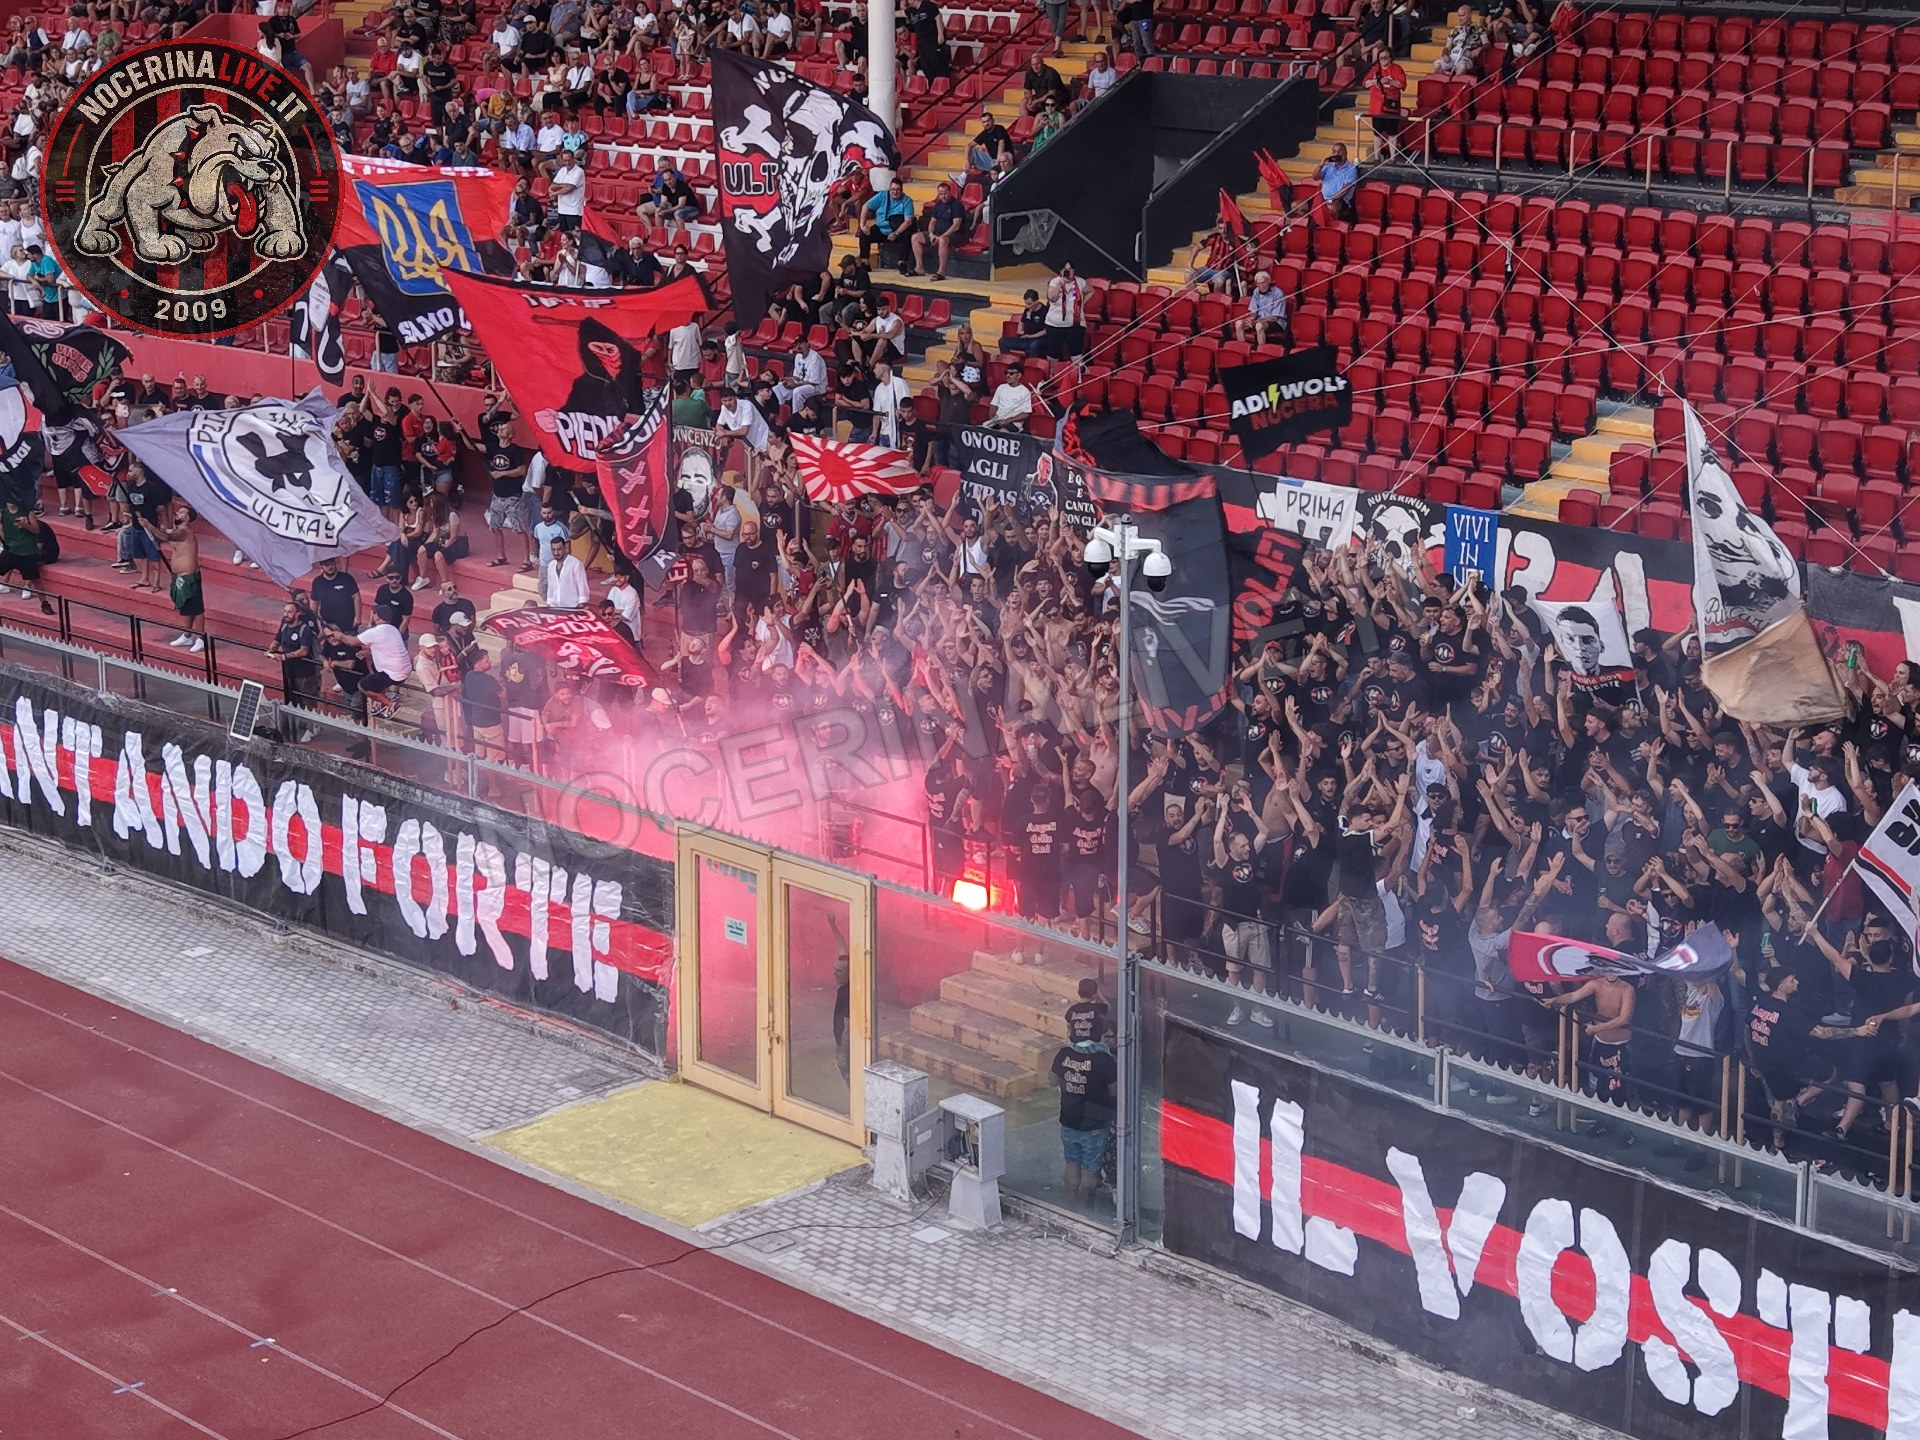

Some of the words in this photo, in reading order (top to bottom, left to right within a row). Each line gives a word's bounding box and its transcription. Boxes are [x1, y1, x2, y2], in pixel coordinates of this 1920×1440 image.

[1231, 391, 1270, 419] ADI
[1280, 376, 1348, 400] WOLF
[961, 430, 1021, 457] ONORE
[968, 459, 1010, 481] AGLI
[960, 480, 1018, 508] LTRAS
[1065, 500, 1096, 514] CANTA
[1286, 490, 1346, 523] PRIMA
[252, 497, 336, 539] ULTRAS
[1453, 513, 1490, 543] VIVI
[1459, 542, 1479, 567] IN
[341, 793, 623, 1004] FORTE
[1231, 1078, 1359, 1277] IL
